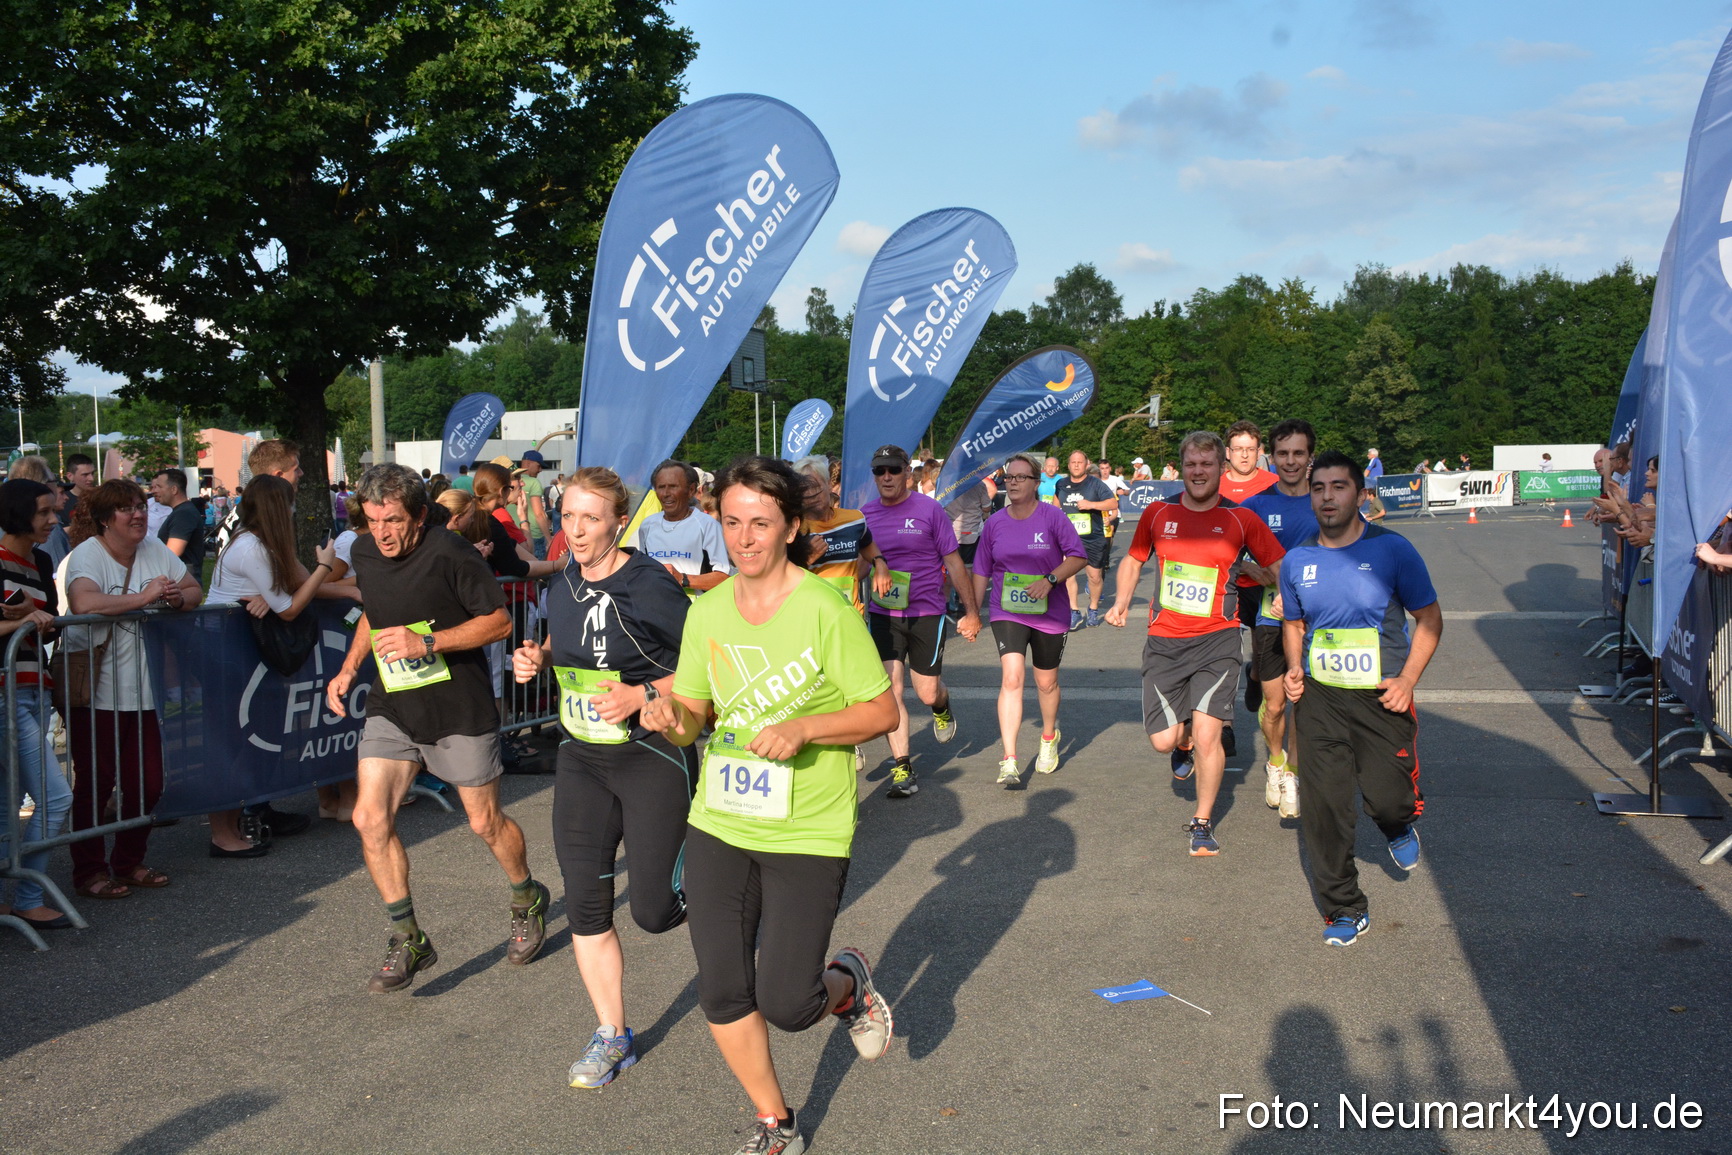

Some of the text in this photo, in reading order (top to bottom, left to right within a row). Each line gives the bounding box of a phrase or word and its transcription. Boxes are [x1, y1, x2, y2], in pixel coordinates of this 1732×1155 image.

[651, 143, 786, 339] Fischer
[699, 183, 801, 338] AUTOMOBILE
[891, 238, 980, 378] Fischer
[924, 264, 991, 376] AUTOMOBILE
[961, 393, 1057, 459] Frischmann
[1023, 413, 1048, 431] Druck
[1061, 386, 1090, 408] Medien
[456, 402, 492, 451] Fischer
[469, 411, 496, 450] AUTOMOBILE
[794, 407, 822, 447] Fischer
[1378, 485, 1411, 497] Frischmann
[1460, 480, 1492, 497] swn
[1524, 476, 1551, 490] AOK
[904, 518, 915, 529] K
[1034, 532, 1044, 543] K
[647, 550, 692, 559] DELPHI
[1167, 580, 1209, 603] 1298
[1316, 652, 1373, 673] 1300
[719, 763, 772, 798] 194
[723, 798, 743, 808] Martina
[743, 802, 762, 811] Hoppe
